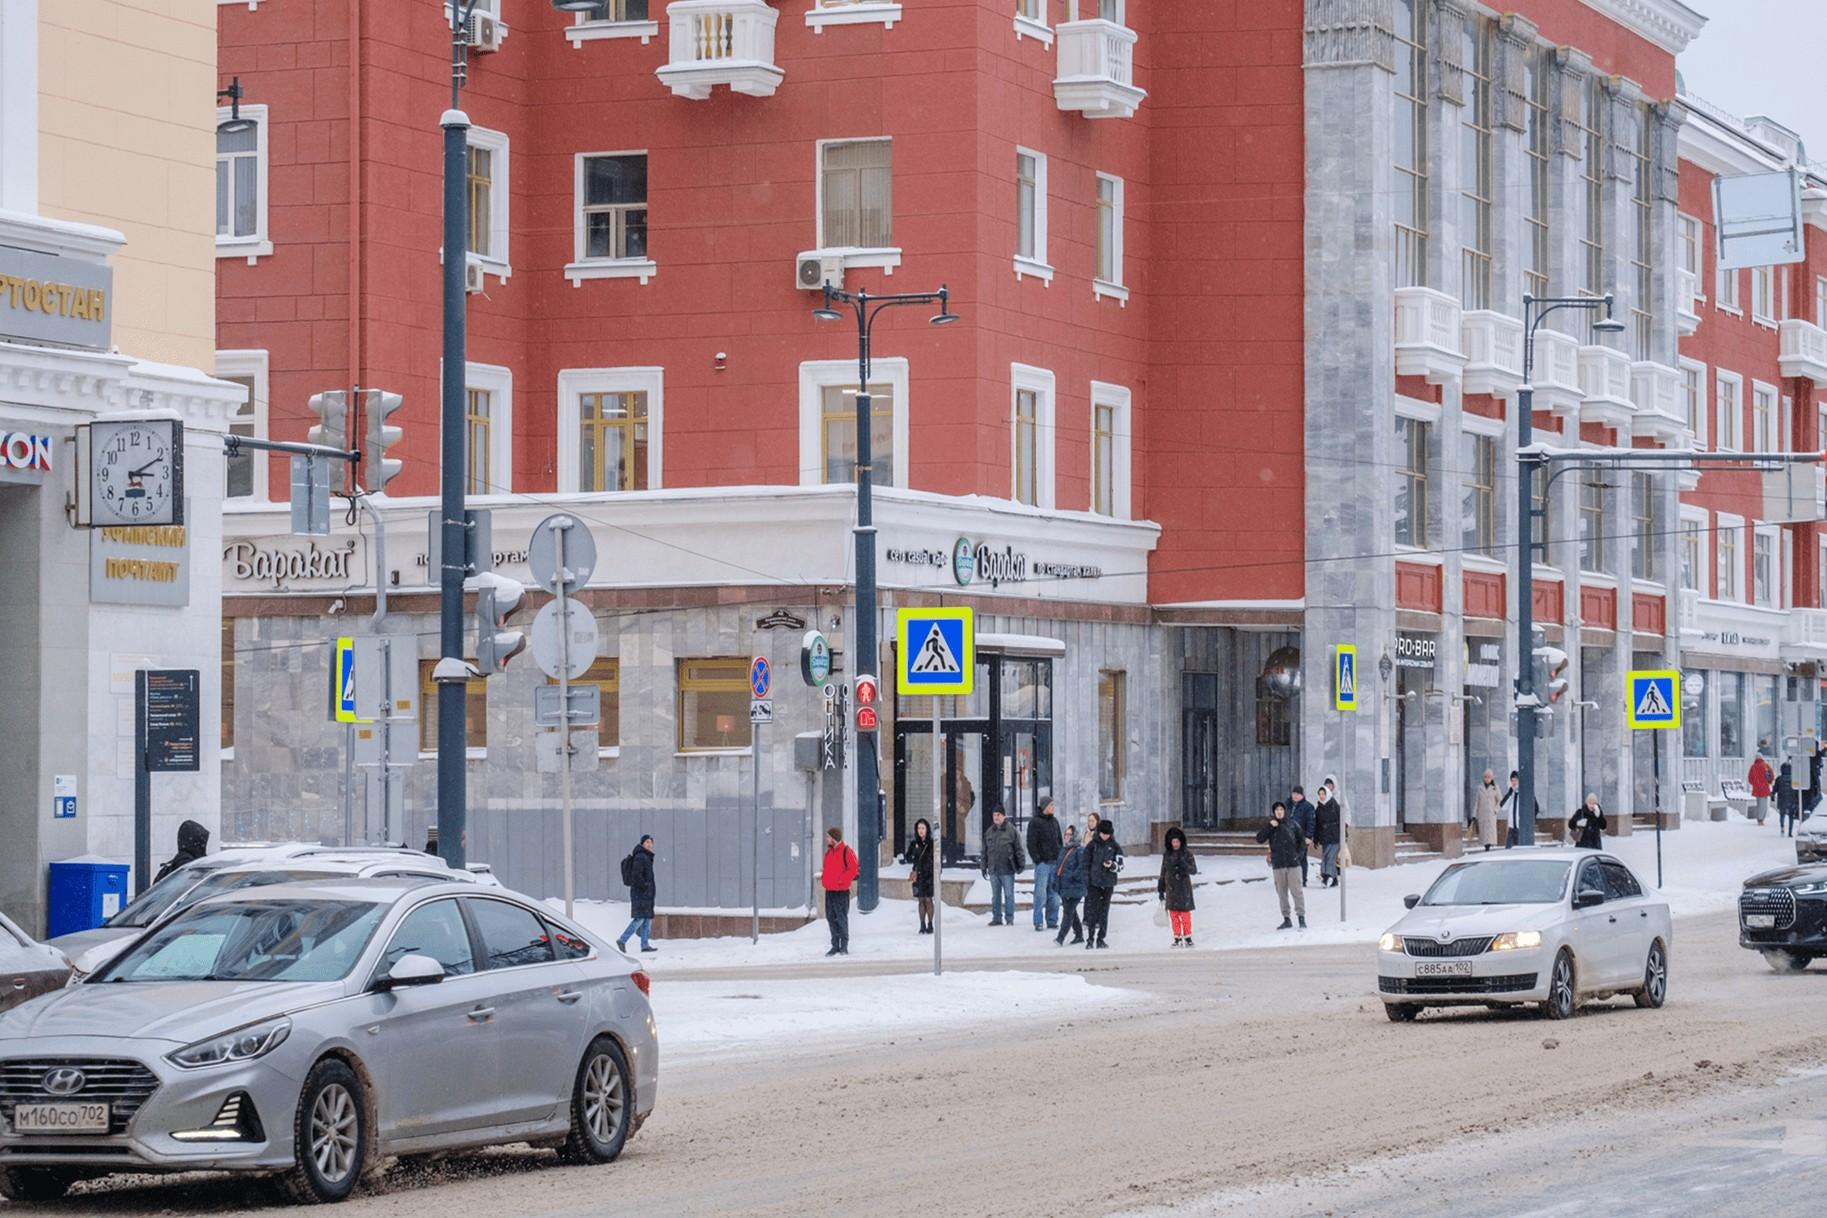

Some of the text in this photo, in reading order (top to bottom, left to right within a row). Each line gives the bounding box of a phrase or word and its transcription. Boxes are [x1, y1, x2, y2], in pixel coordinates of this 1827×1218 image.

[117, 438, 125, 452] 11
[130, 431, 140, 446] 12
[147, 436, 151, 450] 1
[0, 431, 53, 470] ON
[107, 450, 117, 465] 10
[157, 447, 163, 461] 2
[102, 467, 109, 482] 9
[162, 465, 169, 480] 3
[107, 485, 114, 500] 8
[156, 483, 163, 498] 4
[118, 497, 124, 512] 7
[132, 501, 139, 516] 6
[146, 497, 153, 511] 5
[106, 557, 178, 582] ПОЧТАМТ
[223, 541, 355, 588] Баракат
[823, 684, 836, 770] ОПТИКА
